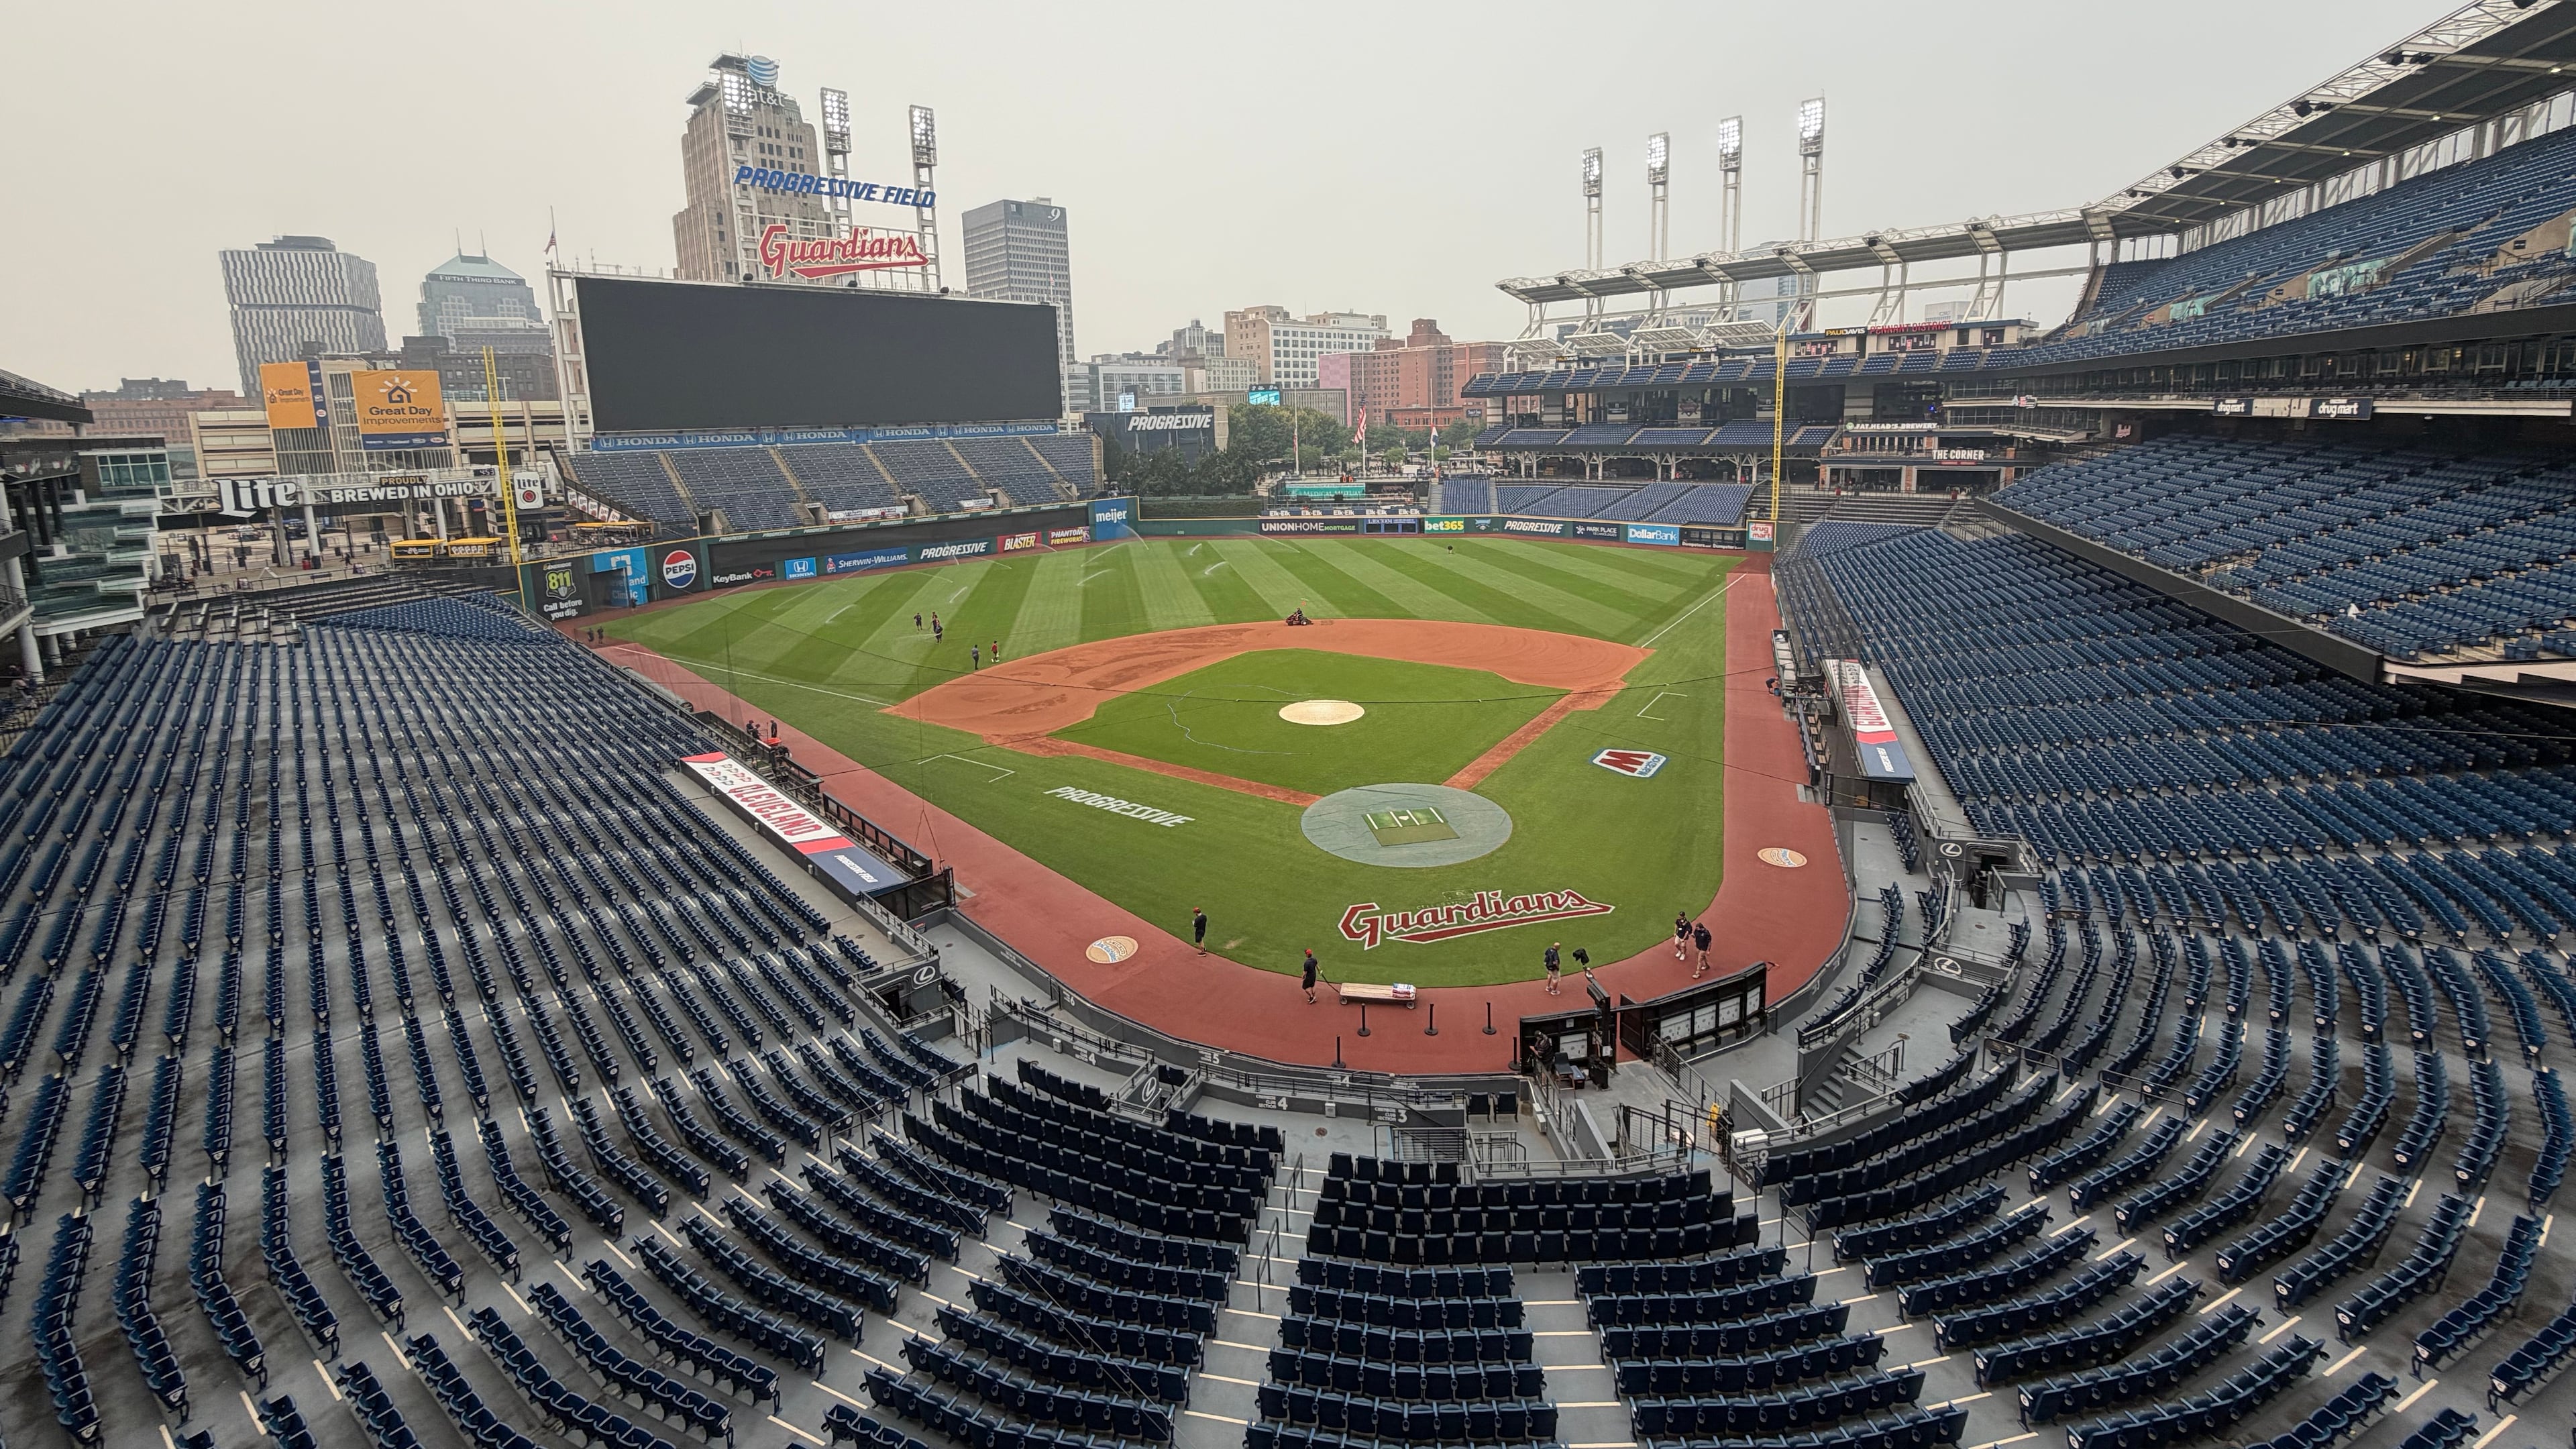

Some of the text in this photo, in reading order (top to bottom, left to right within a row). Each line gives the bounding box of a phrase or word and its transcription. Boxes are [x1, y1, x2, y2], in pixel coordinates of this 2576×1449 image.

[749, 87, 785, 107] at&t
[734, 166, 936, 208] PROGRESSIVE FIELD
[759, 223, 930, 279] Guardians
[1870, 320, 1953, 335] PENNANT DISTRICT
[368, 407, 433, 417] Great Day
[2218, 402, 2245, 415] drug mart
[2318, 402, 2359, 417] drug mart
[363, 416, 442, 425] Improvements
[1127, 414, 1214, 431] PROGRESSIVE
[697, 434, 755, 443] HONDA
[796, 431, 848, 439] HONDA
[885, 428, 931, 436] HONDA
[616, 436, 680, 445] HONDA
[1933, 449, 1984, 460] THE CORNER
[380, 475, 429, 486] PROUDLY
[516, 478, 539, 490] Lite
[213, 478, 297, 519] Lite
[331, 482, 474, 504] BREWED IN OHIO
[1095, 508, 1127, 523] meijer
[1424, 520, 1464, 531] bet365
[1504, 521, 1565, 534] PROGRESSIVE
[1051, 528, 1083, 539] PHANTOM
[1629, 528, 1677, 541] DollarBank
[1004, 535, 1036, 551] BLASTER
[1051, 536, 1083, 545] FIREWORKS
[920, 542, 989, 559] PROGRESSIVE
[839, 553, 908, 568] SHERWIN-WILLIAMS
[665, 563, 695, 576] PEPSI
[547, 570, 572, 590] 811
[713, 572, 753, 584] KeyBank
[543, 599, 583, 612] Call before
[550, 608, 579, 621] you dig.
[1636, 755, 1664, 776] Marathon
[728, 784, 823, 837] CLEVELAND
[1043, 786, 1196, 827] PROGRESSIVE
[1337, 888, 1616, 951] Guardians
[1089, 1053, 1096, 1066] 4
[1212, 1053, 1220, 1065] 5
[1277, 1097, 1288, 1111] 4
[1398, 1109, 1407, 1123] 3
